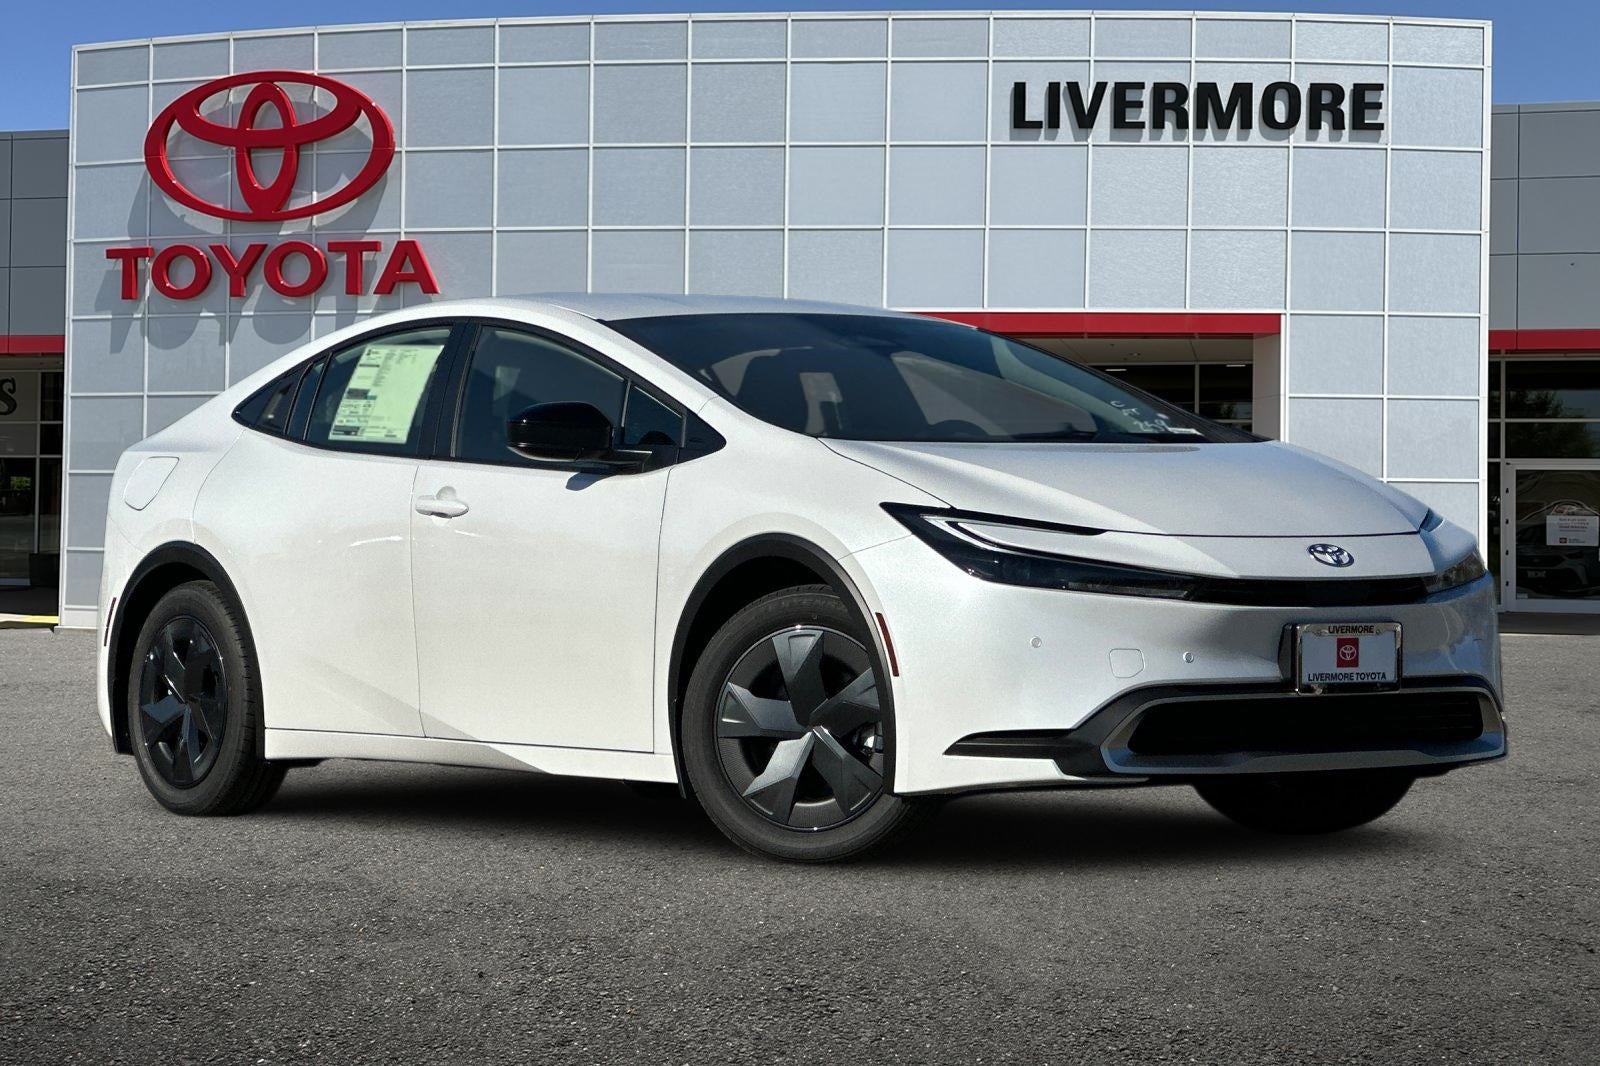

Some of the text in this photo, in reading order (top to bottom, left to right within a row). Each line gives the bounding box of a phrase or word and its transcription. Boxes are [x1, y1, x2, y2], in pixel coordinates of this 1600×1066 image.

[1012, 81, 1385, 131] LIVERMORE
[106, 239, 440, 301] TOYOTA
[1328, 625, 1375, 634] LIVERMORE
[1308, 672, 1387, 682] LIVERMORE TOYOTA
